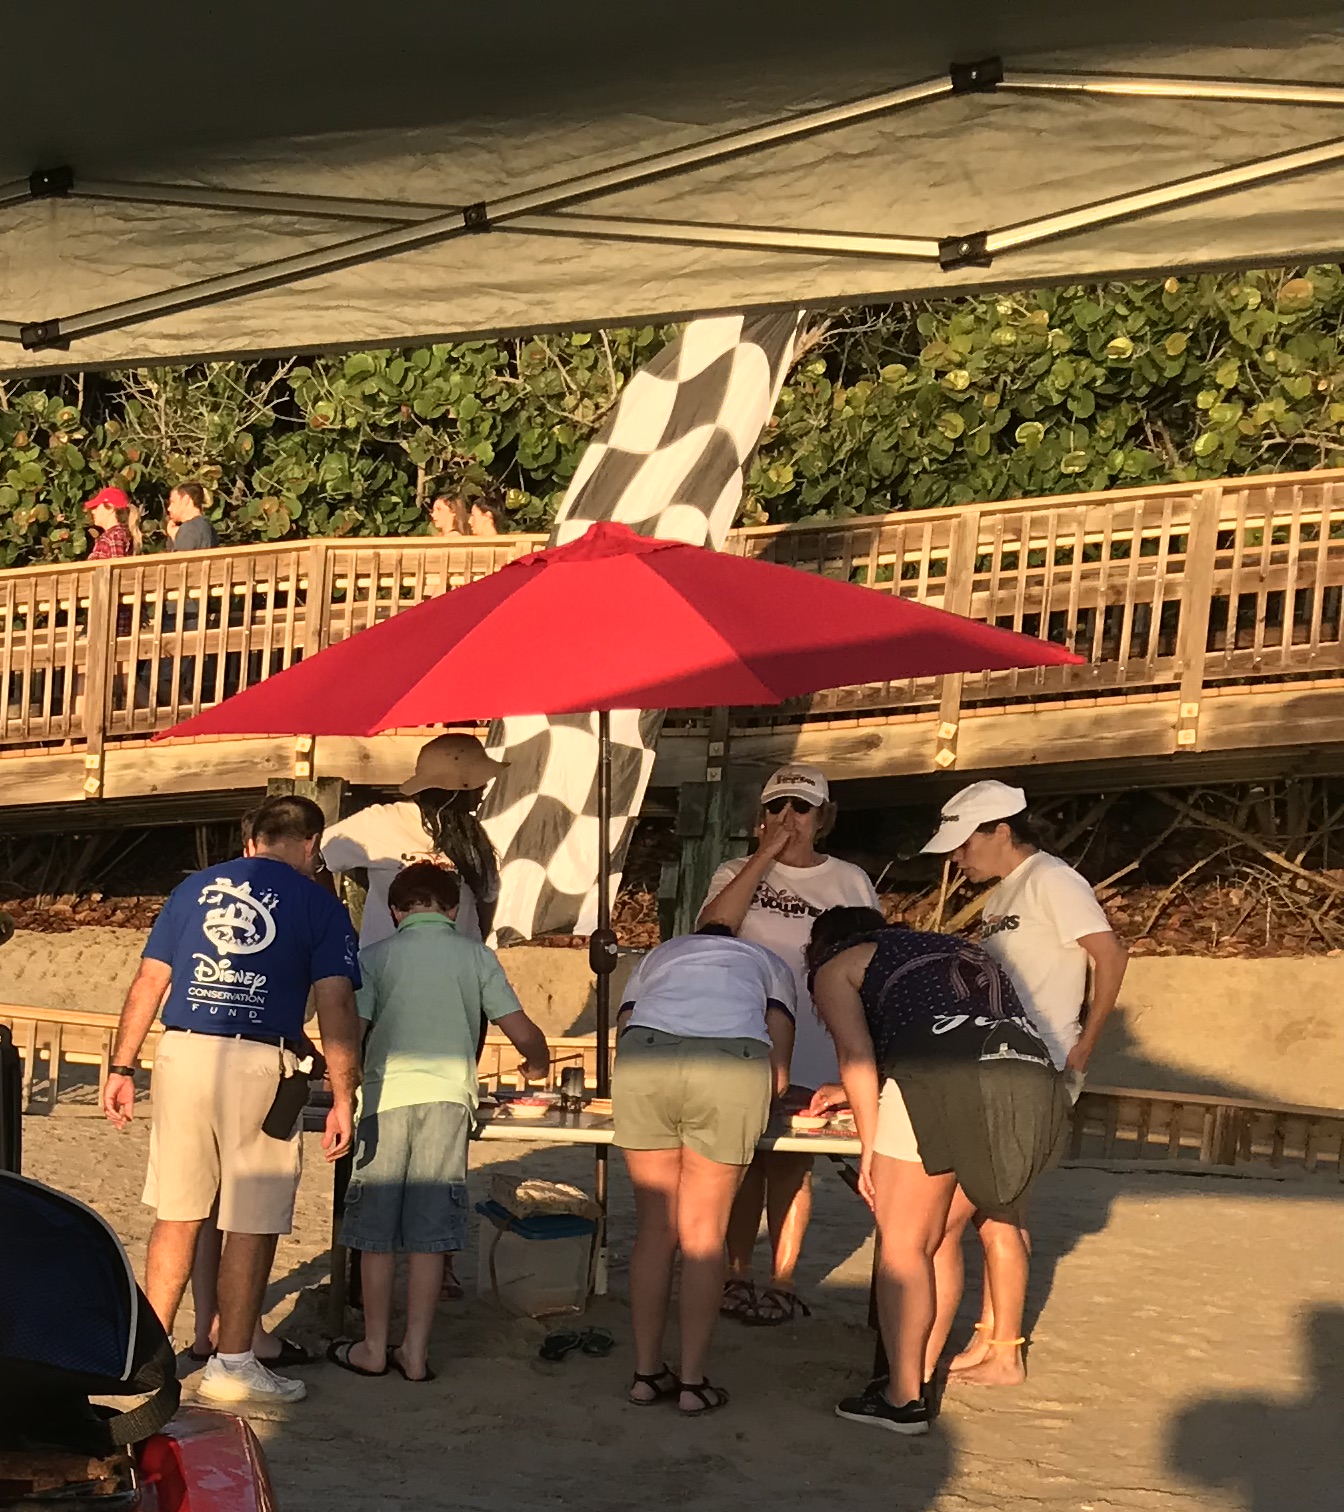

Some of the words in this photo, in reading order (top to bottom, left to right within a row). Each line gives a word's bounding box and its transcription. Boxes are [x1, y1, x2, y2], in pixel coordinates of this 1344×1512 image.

[192, 952, 267, 995] Disney
[187, 987, 265, 1004] CONSERVATION
[192, 1003, 258, 1019] FUND
